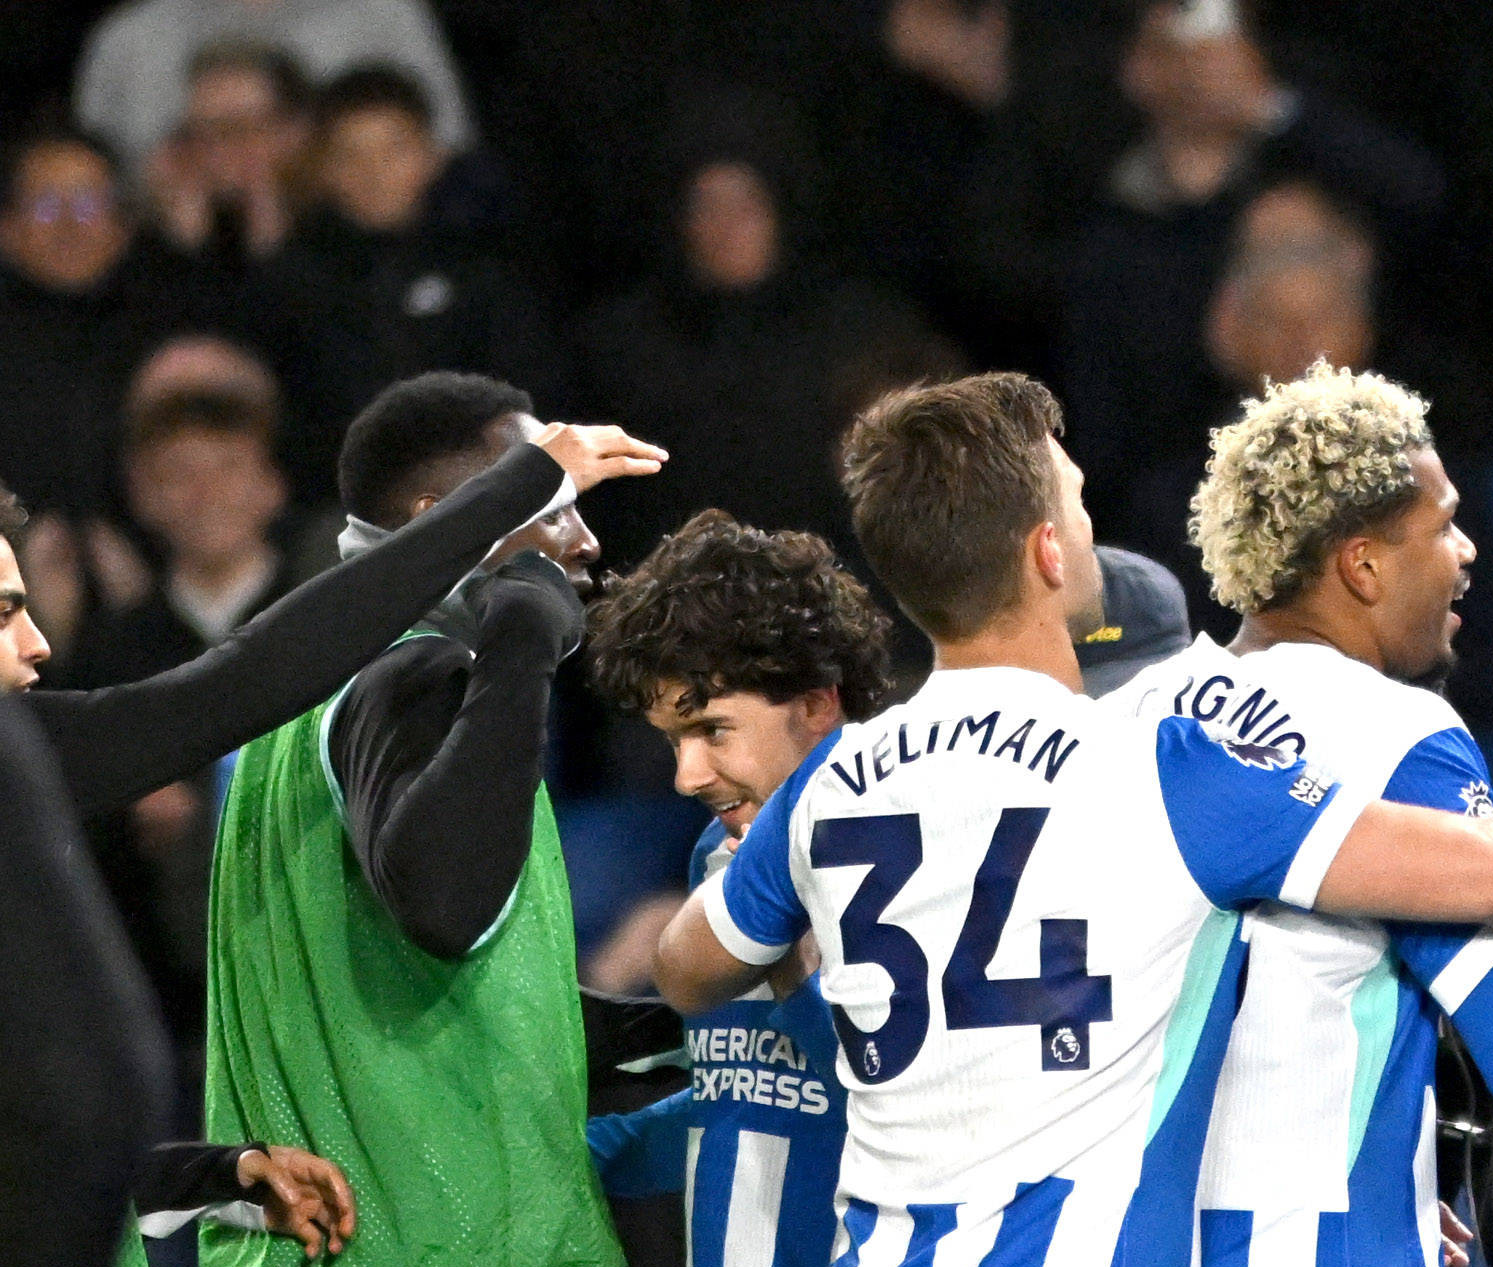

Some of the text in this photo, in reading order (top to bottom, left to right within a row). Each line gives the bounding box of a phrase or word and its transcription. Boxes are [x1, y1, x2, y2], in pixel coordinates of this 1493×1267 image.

[830, 710, 1080, 797] VELTMAN
[810, 807, 1114, 1085] 34
[687, 1027, 807, 1072] MERICA
[692, 1066, 830, 1116] EXPRESS
